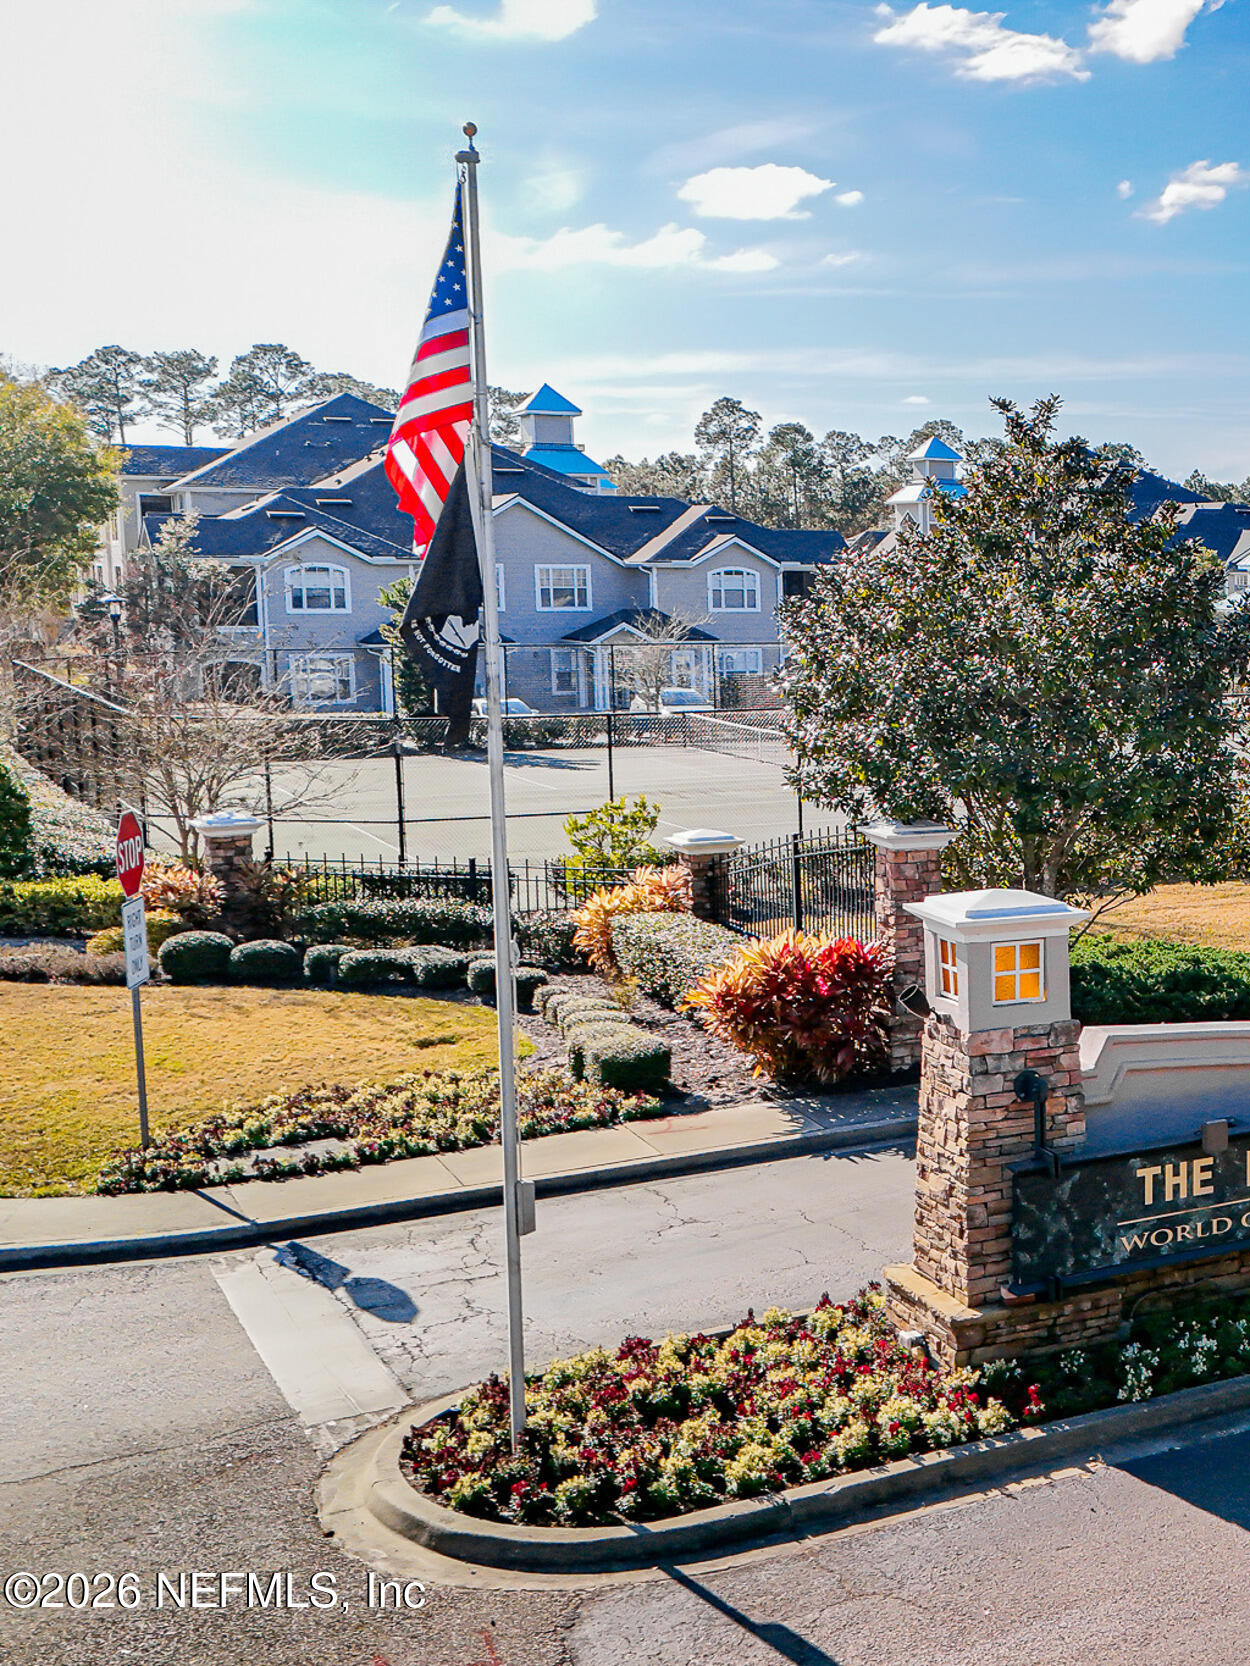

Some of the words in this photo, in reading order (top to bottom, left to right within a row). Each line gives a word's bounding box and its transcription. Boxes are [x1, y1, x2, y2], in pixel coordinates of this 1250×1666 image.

[413, 629, 426, 644] NOT
[118, 835, 142, 874] STOP
[1136, 1156, 1214, 1206] THE
[1120, 1217, 1233, 1252] WORLD
